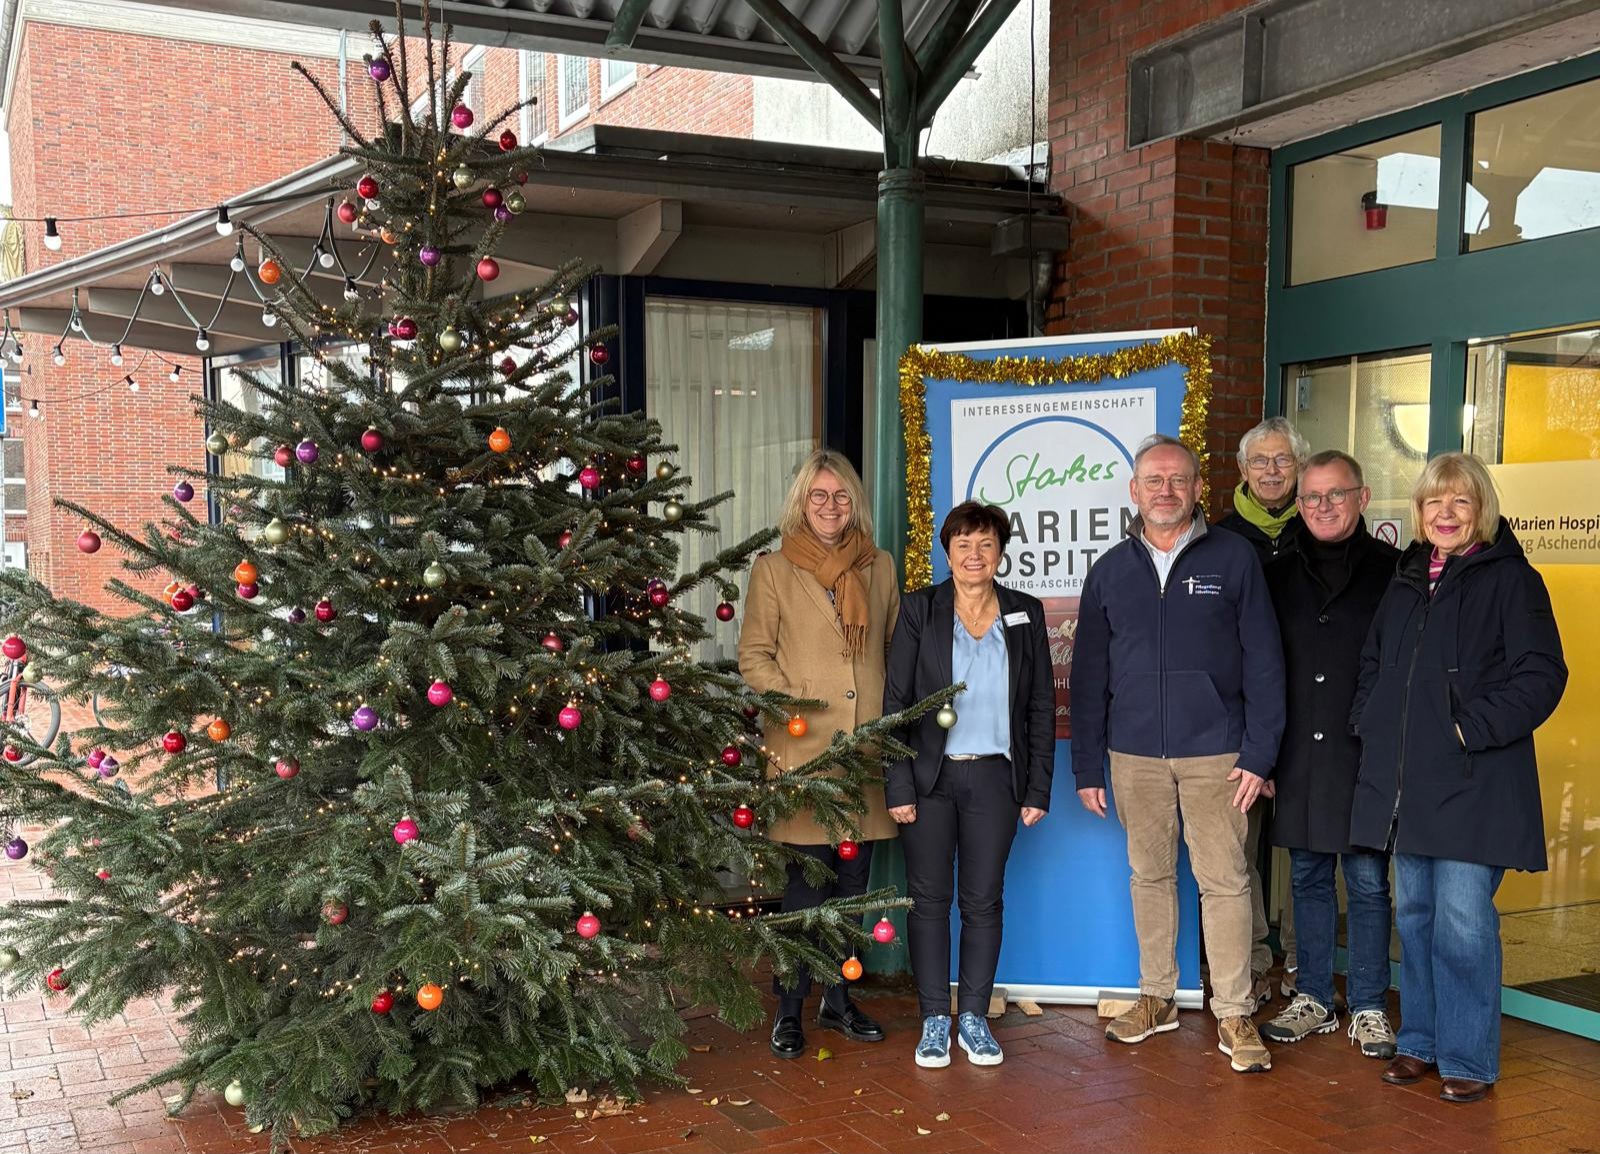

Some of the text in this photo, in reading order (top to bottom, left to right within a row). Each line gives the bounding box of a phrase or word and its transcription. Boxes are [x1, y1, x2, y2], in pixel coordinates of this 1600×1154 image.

[963, 396, 1145, 417] INTERESSENGEMEINSCHAFT
[979, 452, 1119, 505] Starkes
[1007, 507, 1133, 544] ARIEN
[1508, 514, 1600, 534] Marien Hospi
[995, 548, 1098, 578] OSPIT
